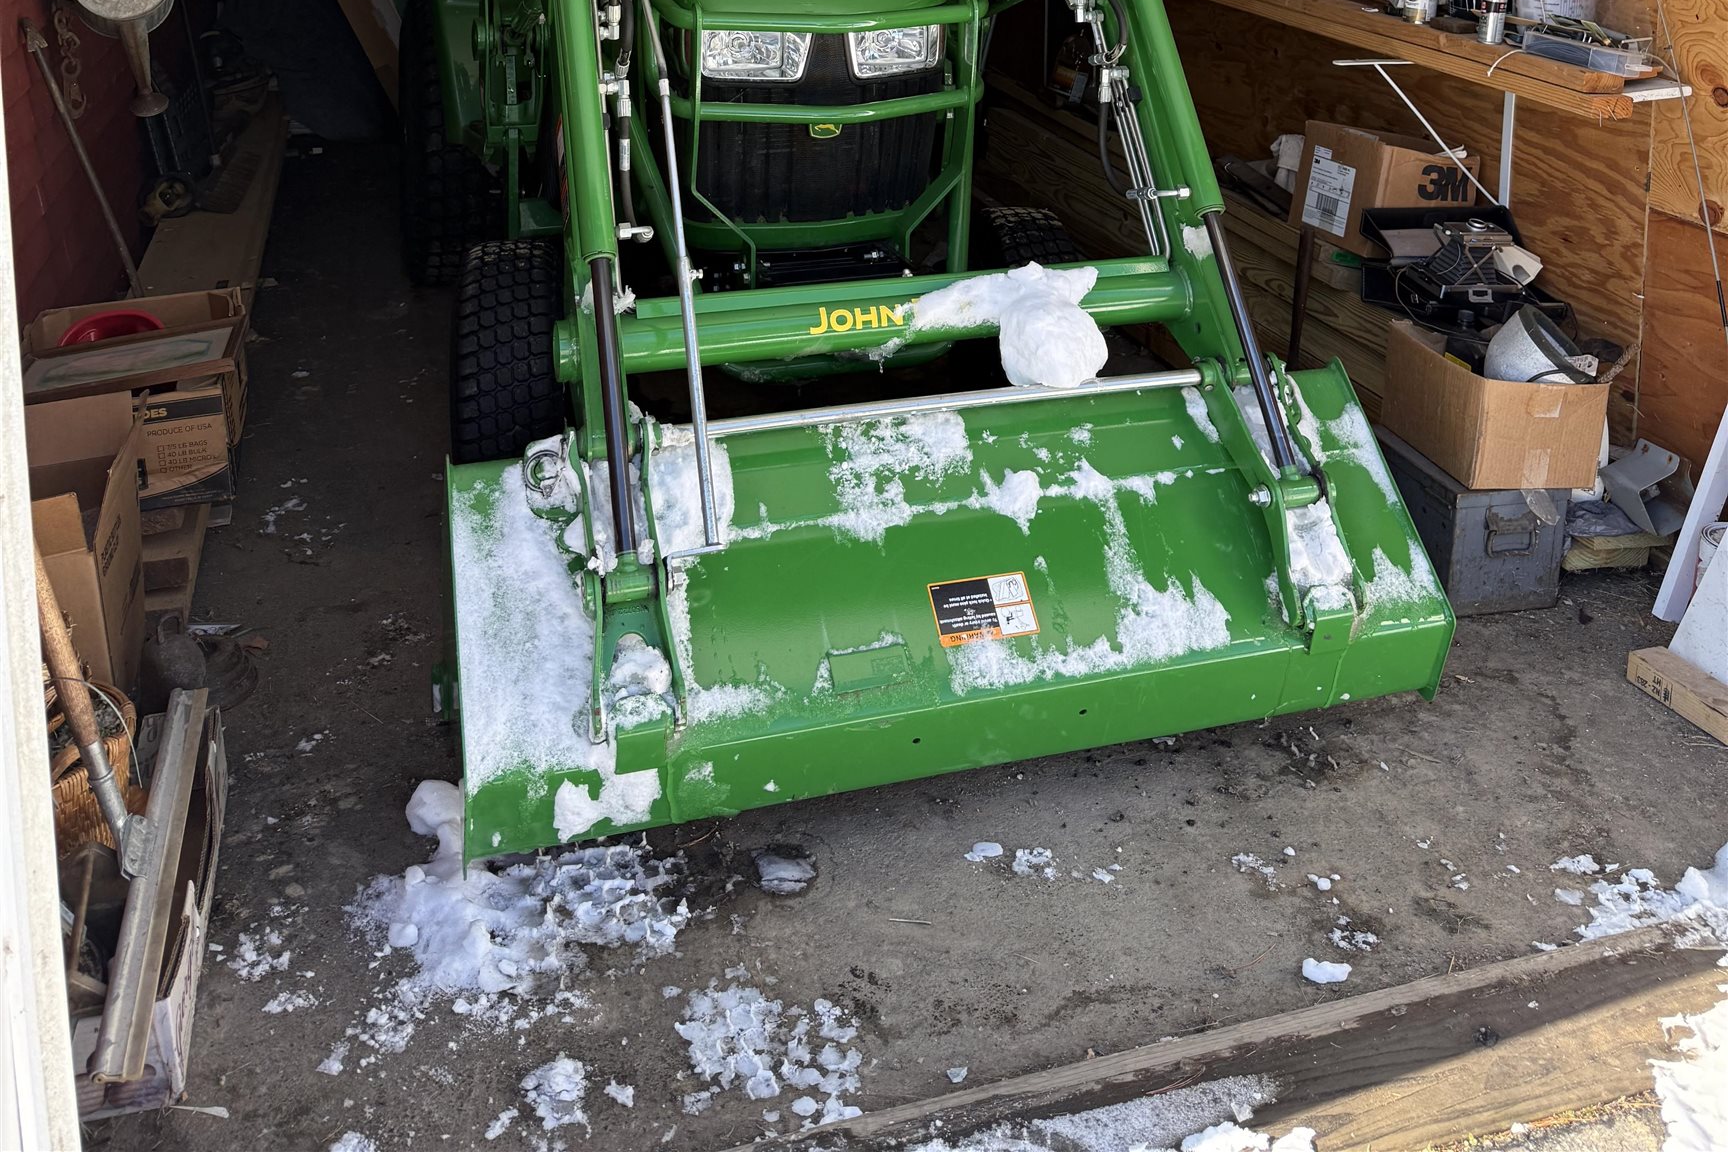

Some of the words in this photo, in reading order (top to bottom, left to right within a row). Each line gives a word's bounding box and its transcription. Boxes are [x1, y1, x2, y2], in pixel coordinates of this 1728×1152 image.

[1417, 164, 1472, 201] 3M
[809, 304, 904, 335] JOHN
[147, 426, 183, 437] PRODUCE
[197, 423, 213, 431] USA
[168, 464, 193, 473] OTHER
